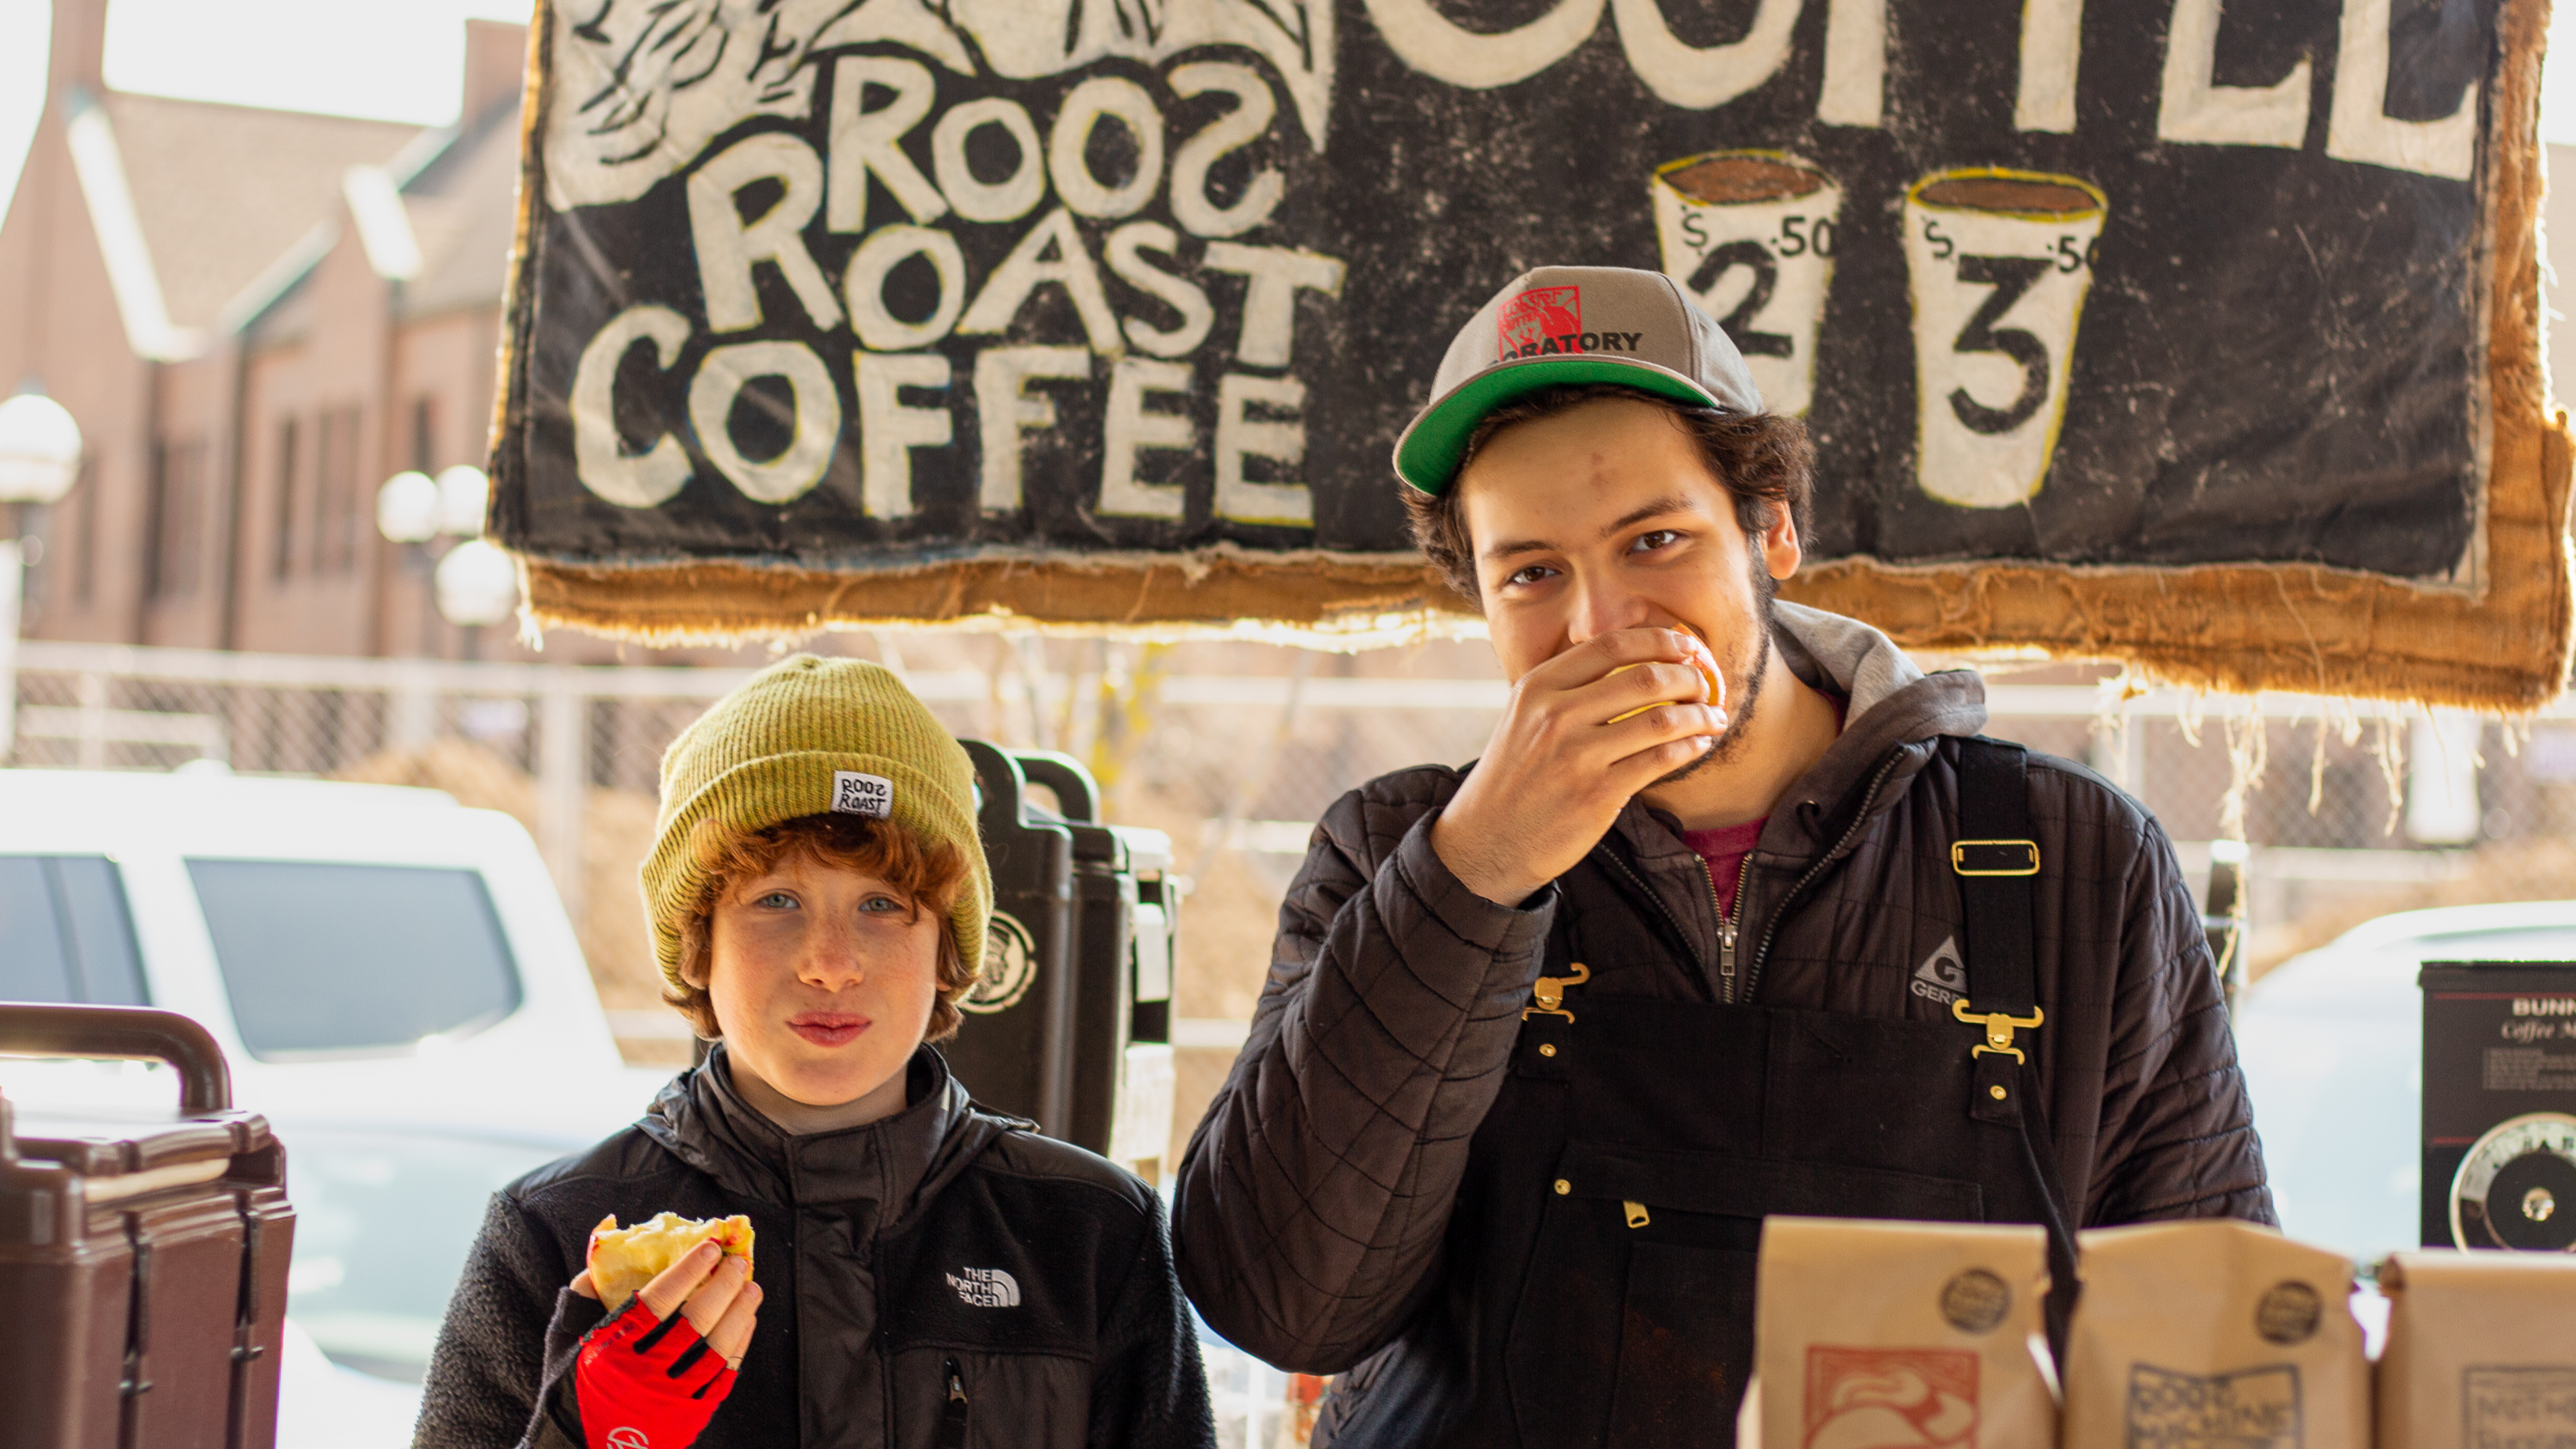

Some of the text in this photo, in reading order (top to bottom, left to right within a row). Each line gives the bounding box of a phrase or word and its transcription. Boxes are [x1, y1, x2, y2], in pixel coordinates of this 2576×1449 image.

[828, 54, 1283, 237] ROOS
[687, 132, 1347, 368] ROAST
[569, 306, 1315, 527] COFFEE
[838, 793, 886, 811] ROAST
[2500, 1020, 2555, 1044] Coffee
[946, 1272, 993, 1295] NORTH
[963, 1267, 993, 1282] THE
[958, 1291, 993, 1307] FACE
